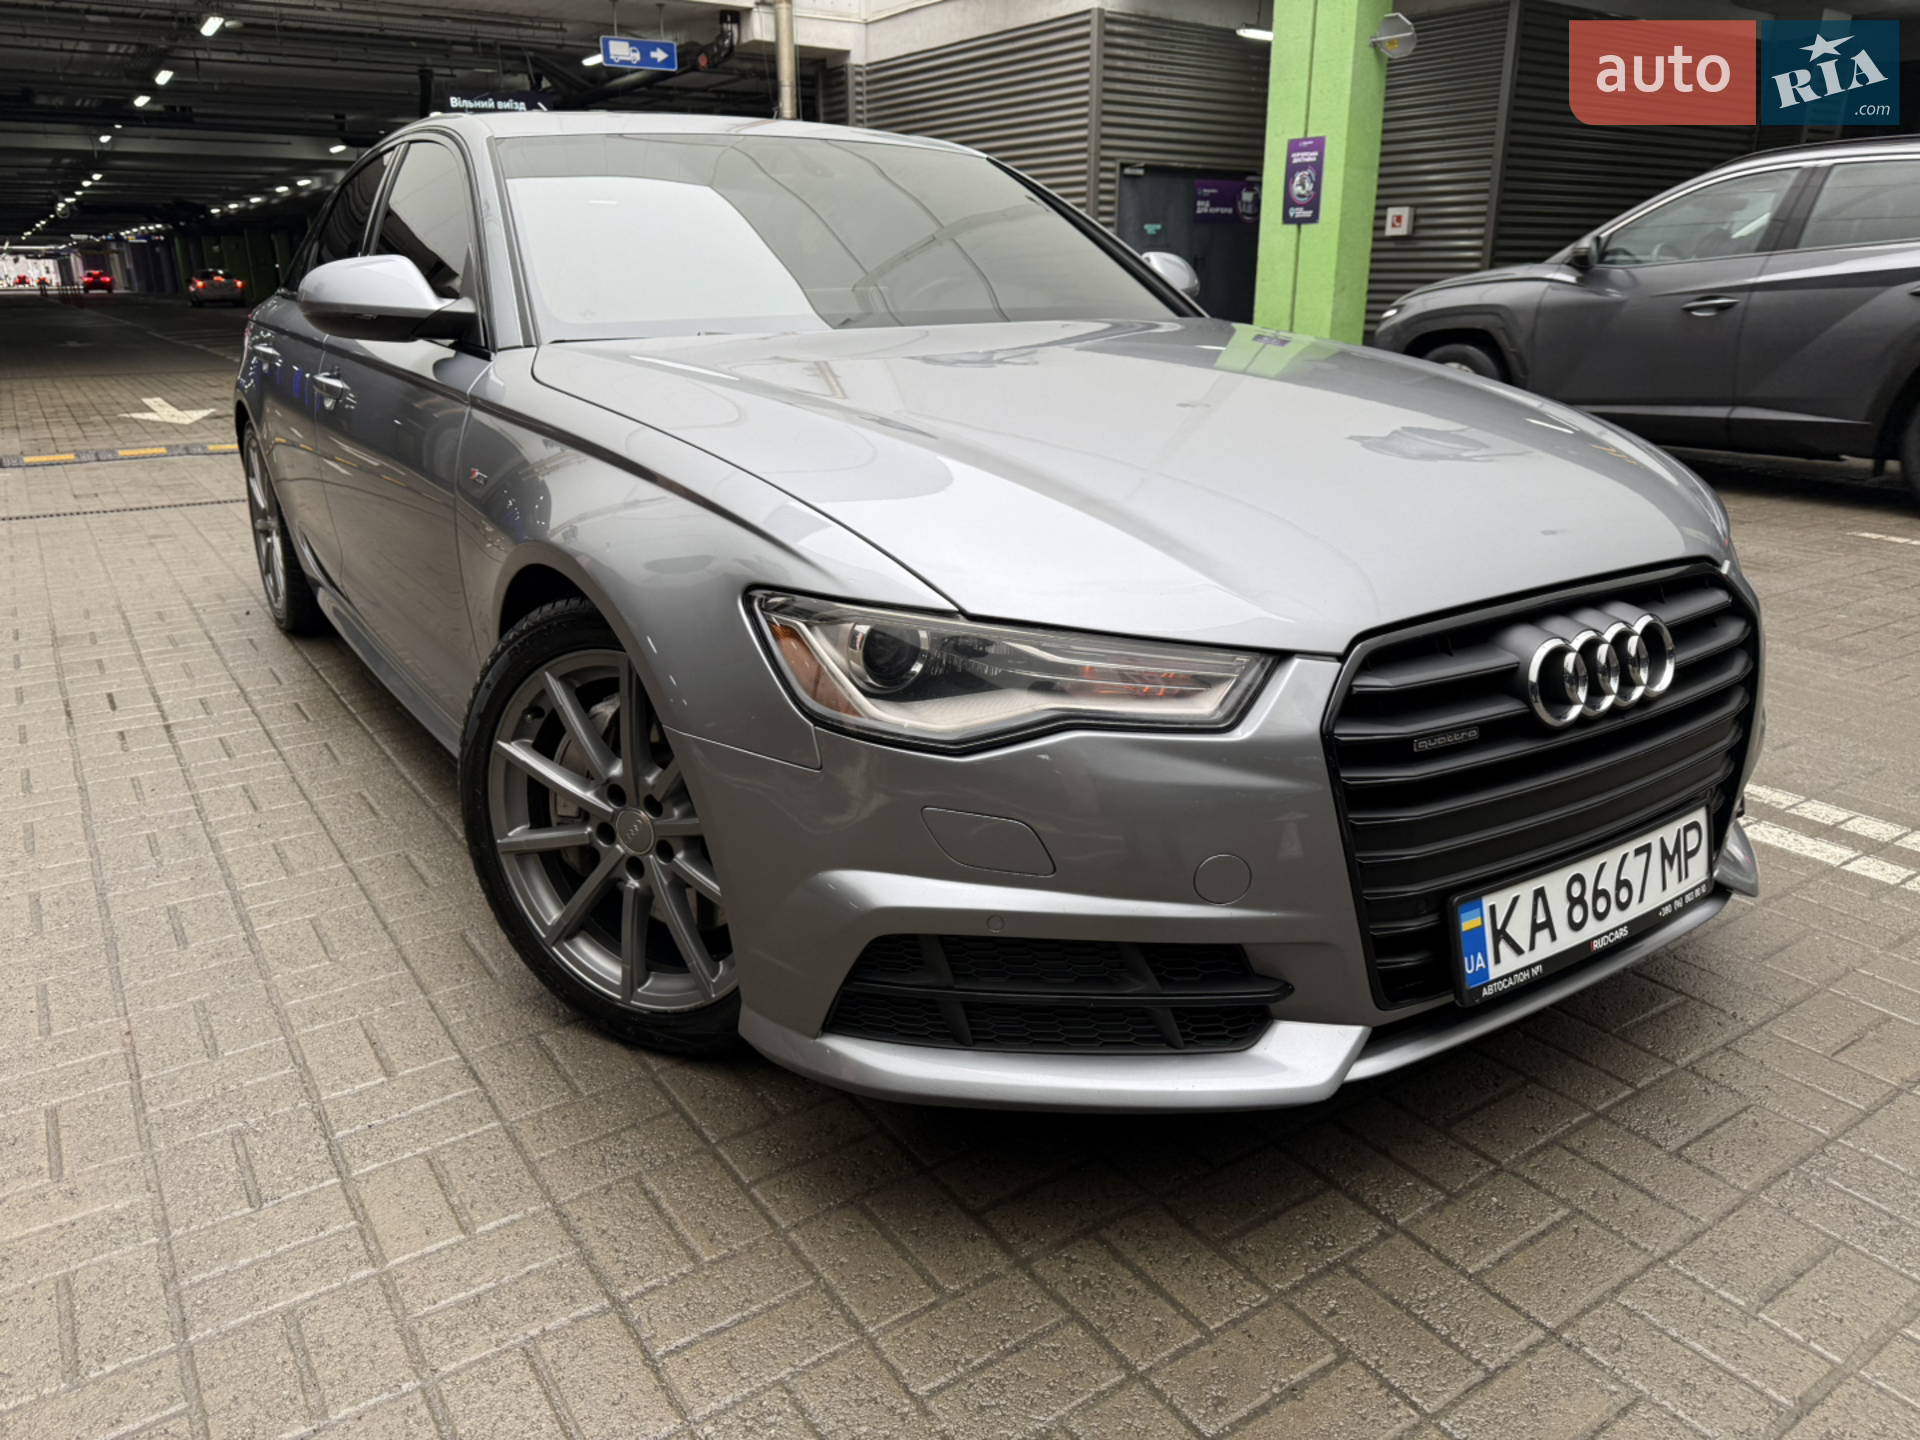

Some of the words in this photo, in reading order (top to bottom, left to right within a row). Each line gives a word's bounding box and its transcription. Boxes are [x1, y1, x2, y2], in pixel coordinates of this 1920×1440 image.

[449, 96, 495, 109] Вільний
[497, 98, 527, 111] виїзд
[1418, 730, 1477, 749] quattro
[1464, 952, 1486, 974] UA
[1488, 885, 1557, 966] KA
[1566, 841, 1653, 932] 8667
[1659, 820, 1703, 892] MP
[1482, 968, 1530, 998] АВТОСАЛОН
